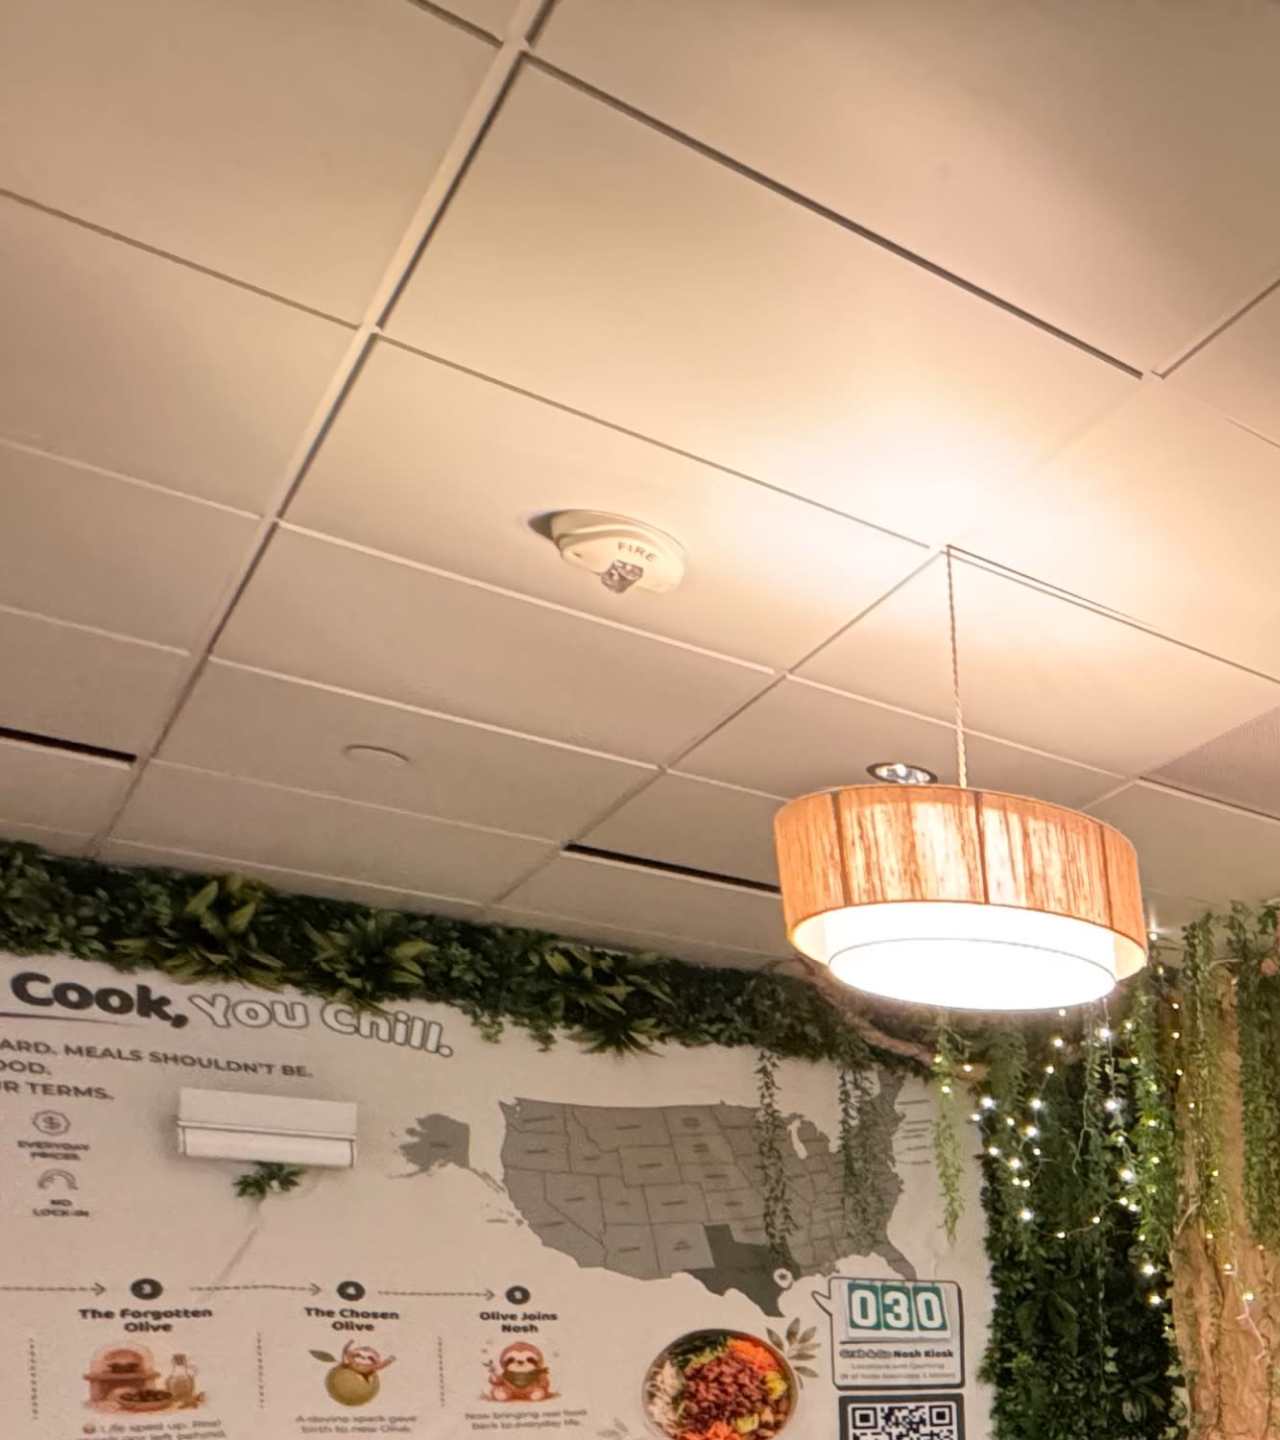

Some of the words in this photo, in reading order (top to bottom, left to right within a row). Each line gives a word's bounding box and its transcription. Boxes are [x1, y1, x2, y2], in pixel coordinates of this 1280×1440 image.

[617, 541, 657, 562] FIRE
[11, 972, 188, 1028] Cook,
[189, 993, 309, 1028] You
[320, 1001, 454, 1058] Chill.
[0, 1038, 57, 1056] ARD.
[64, 1044, 142, 1061] MEALS
[149, 1050, 274, 1076] SHOULDN'T
[281, 1064, 314, 1077] BE.
[0, 1059, 52, 1075] OOD.
[27, 1081, 114, 1100] TERMS.
[78, 1308, 116, 1320] The
[120, 1307, 213, 1321] Forgotten
[304, 1306, 335, 1318] The
[339, 1308, 400, 1320] Chosen
[479, 1311, 518, 1321] Olive
[521, 1311, 558, 1321] Joins
[851, 1288, 944, 1329] 030
[124, 1322, 172, 1333] Olive
[331, 1320, 375, 1332] Olive
[501, 1323, 538, 1333] Nosh
